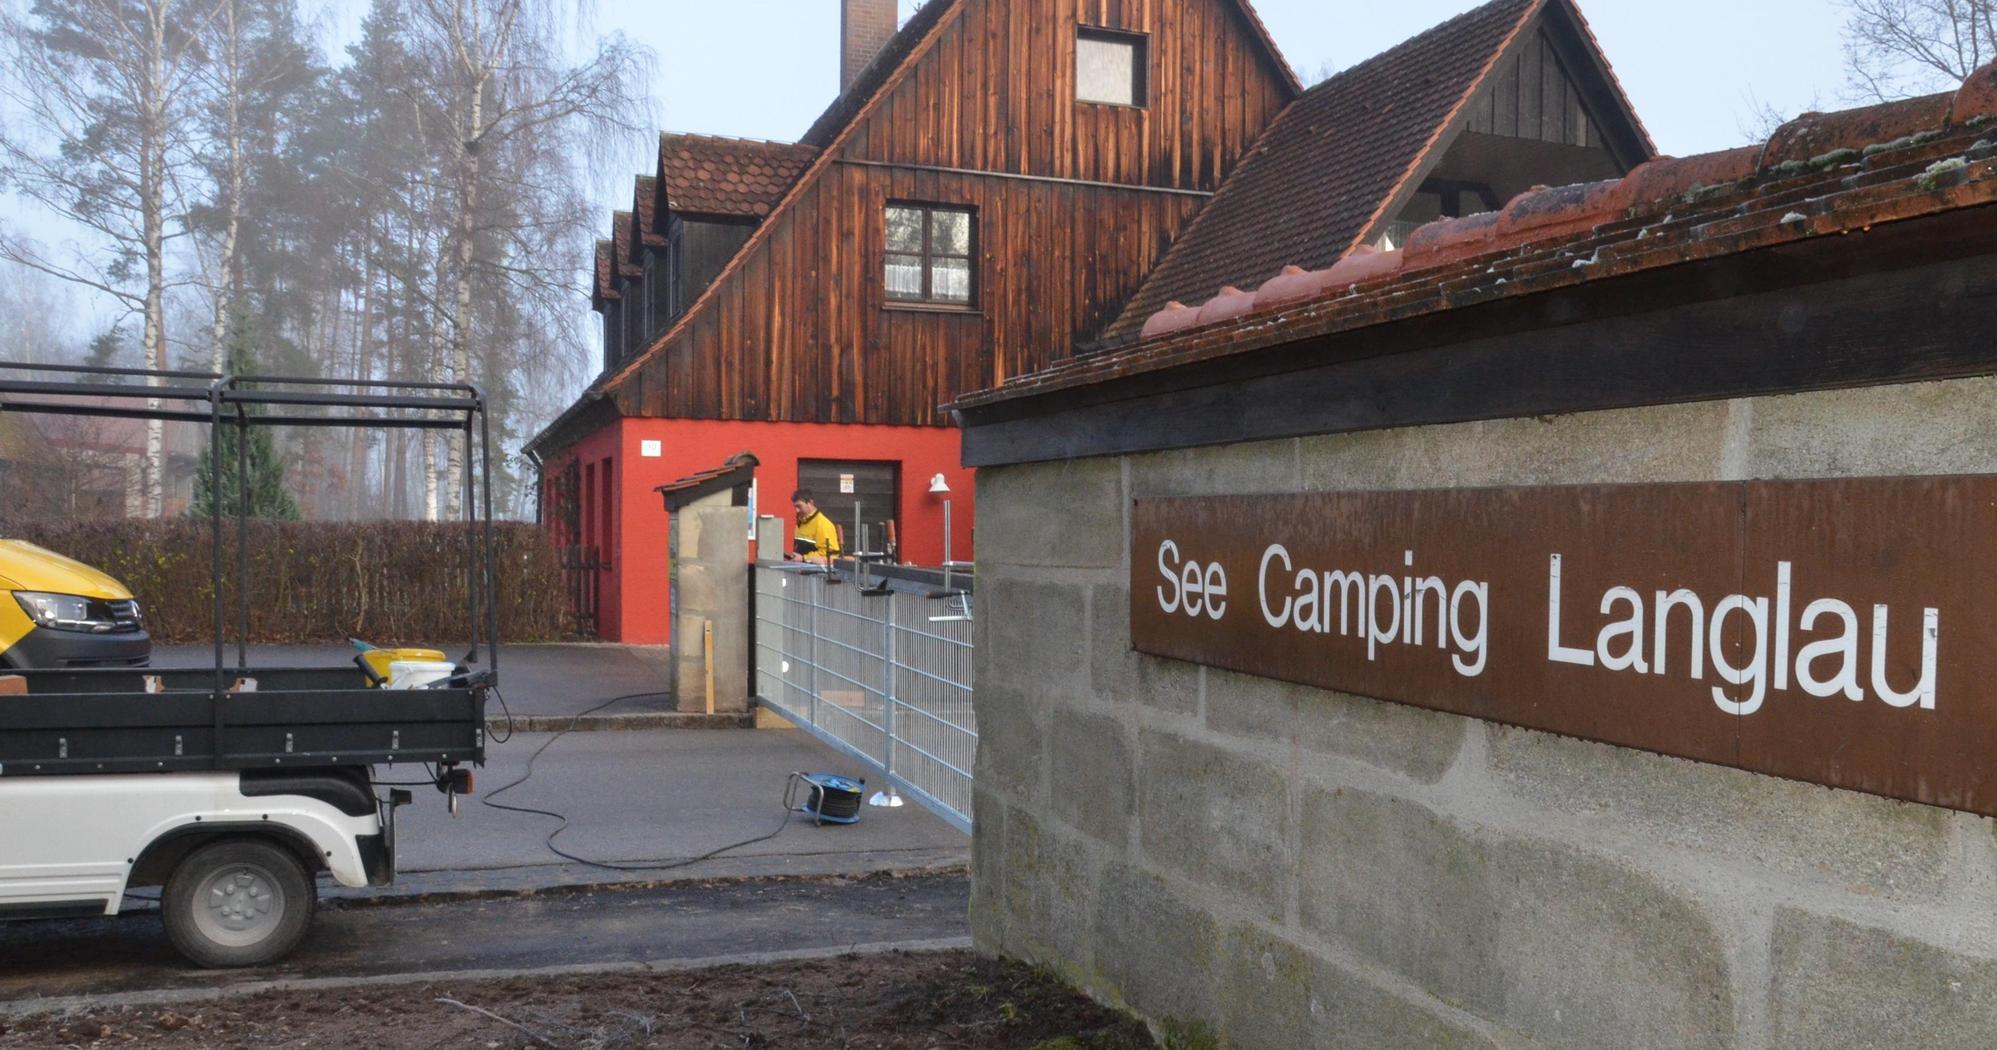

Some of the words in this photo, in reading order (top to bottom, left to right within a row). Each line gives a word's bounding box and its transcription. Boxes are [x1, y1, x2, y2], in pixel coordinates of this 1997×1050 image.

[1156, 538, 1228, 622] See
[1258, 542, 1489, 678] Camping
[1547, 552, 1940, 717] Langlau
